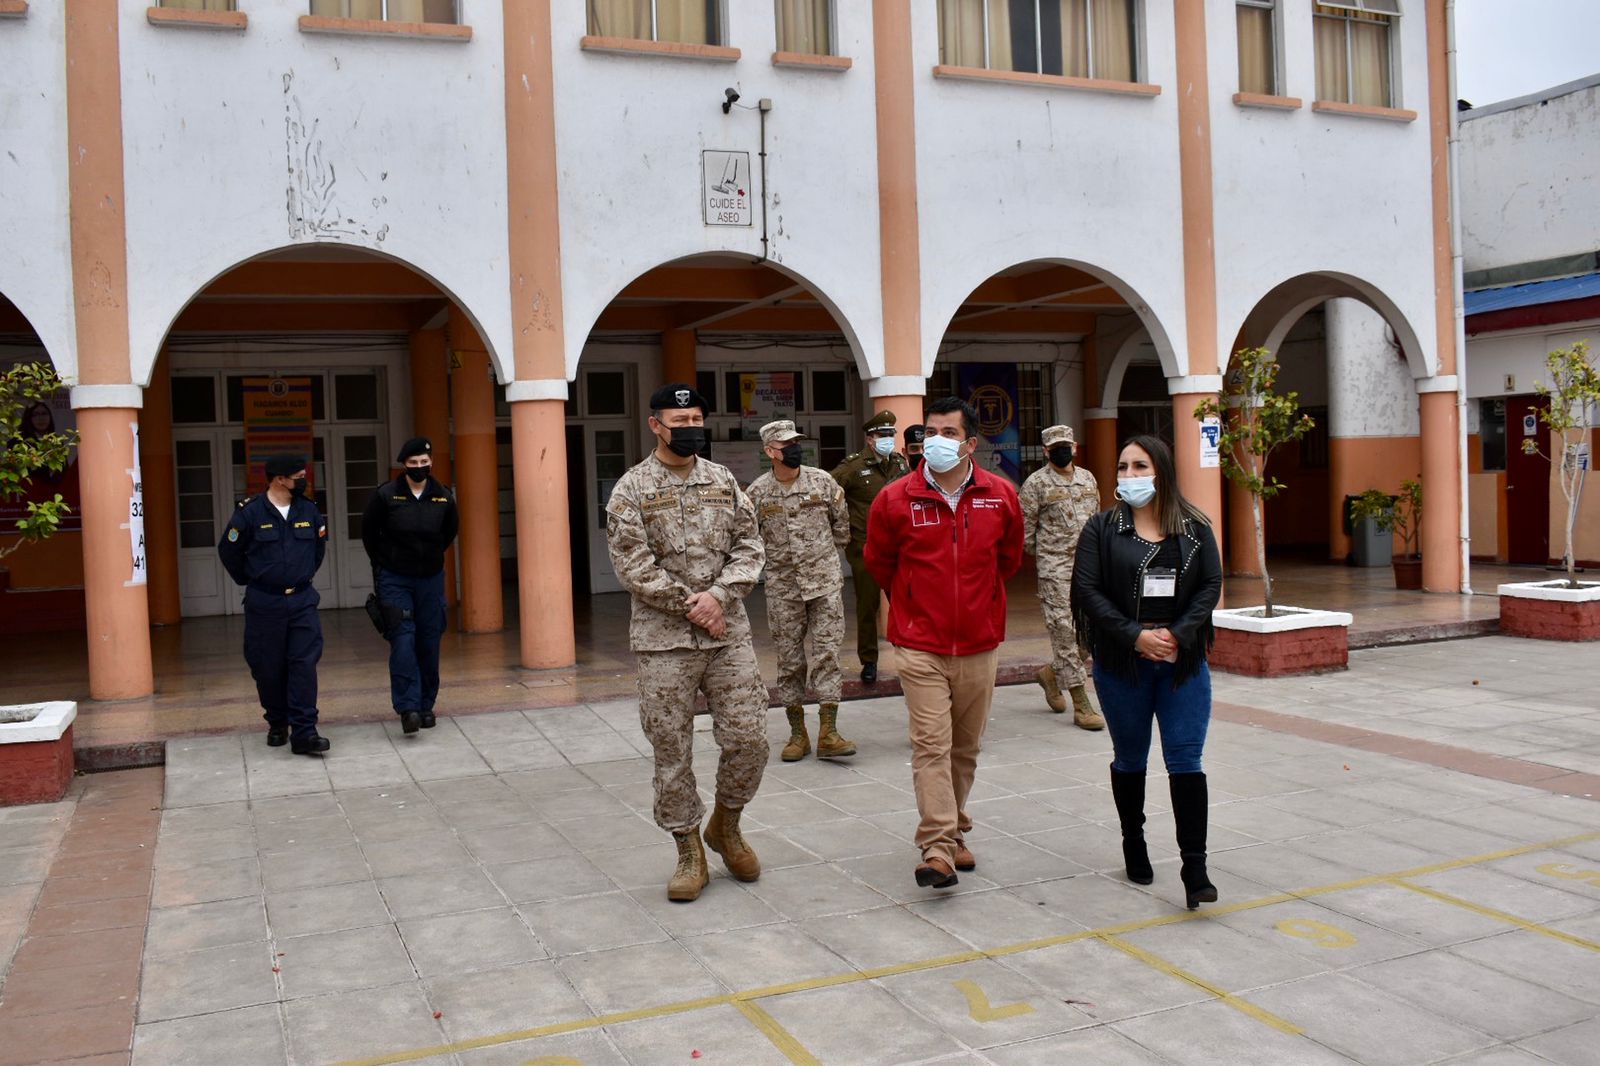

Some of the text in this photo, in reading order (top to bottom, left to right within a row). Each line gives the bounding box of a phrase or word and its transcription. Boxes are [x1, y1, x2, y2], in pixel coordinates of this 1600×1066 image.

[709, 197, 747, 210] CUIDE EL
[717, 211, 740, 223] ASEO
[133, 555, 145, 570] 41
